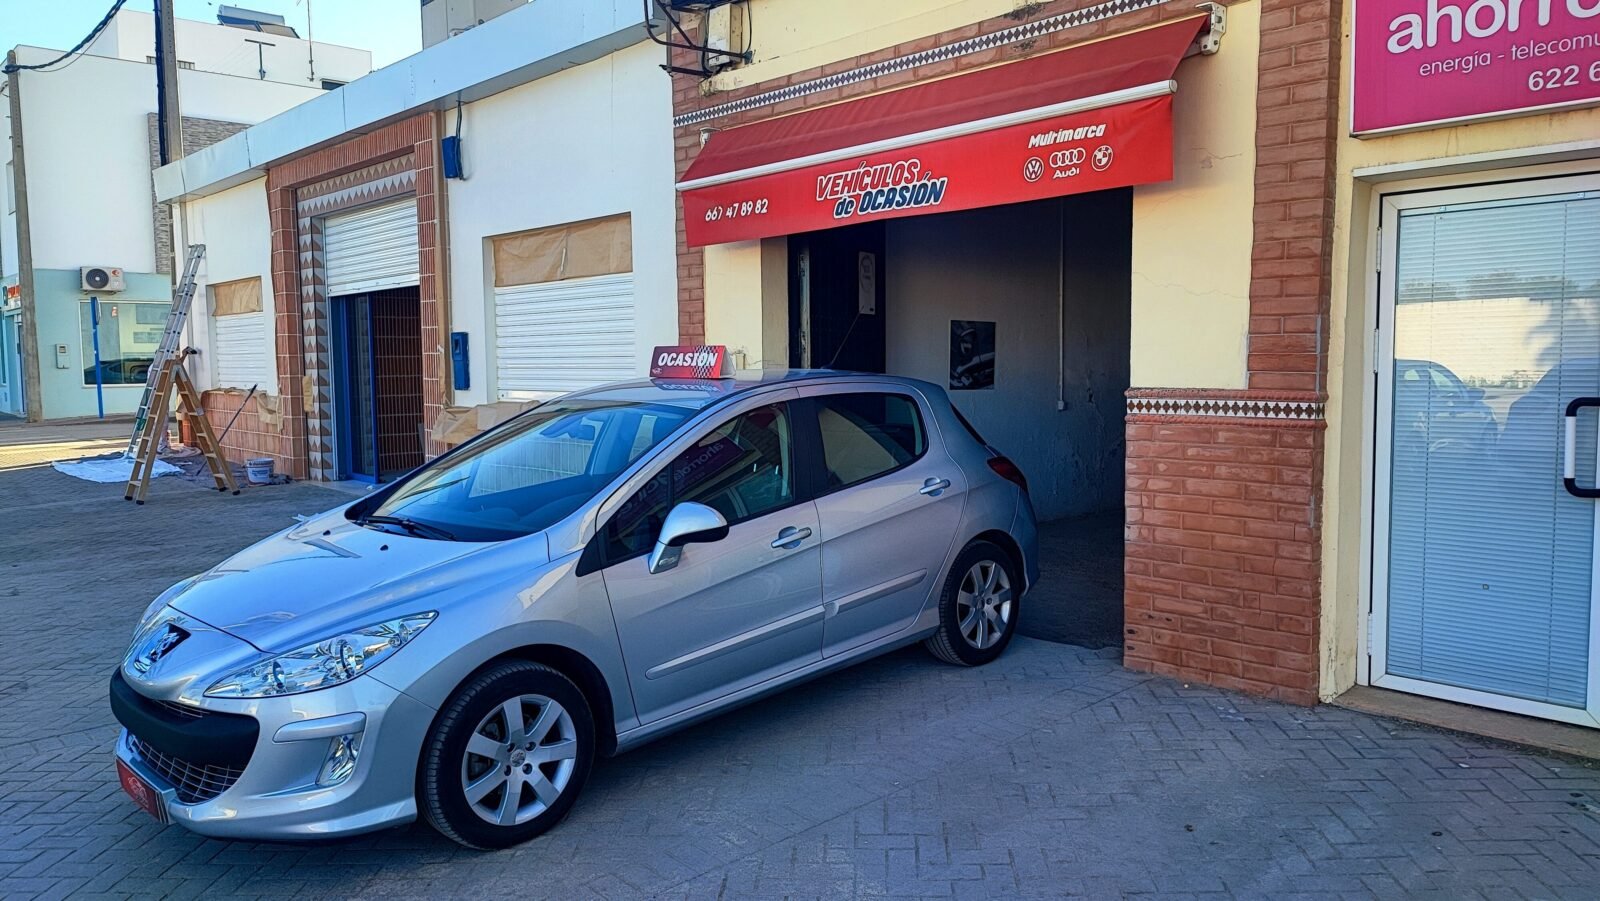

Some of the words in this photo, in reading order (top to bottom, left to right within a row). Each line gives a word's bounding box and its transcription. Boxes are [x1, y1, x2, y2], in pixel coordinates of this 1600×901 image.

[1419, 50, 1491, 76] energía
[1528, 64, 1580, 92] 622
[816, 158, 921, 201] VEHÍCULOS
[1053, 166, 1080, 179] Audi
[726, 202, 740, 219] 47
[740, 200, 754, 217] 89
[755, 198, 769, 214] 82
[833, 194, 856, 219] de
[858, 171, 949, 215] OCASIÓN
